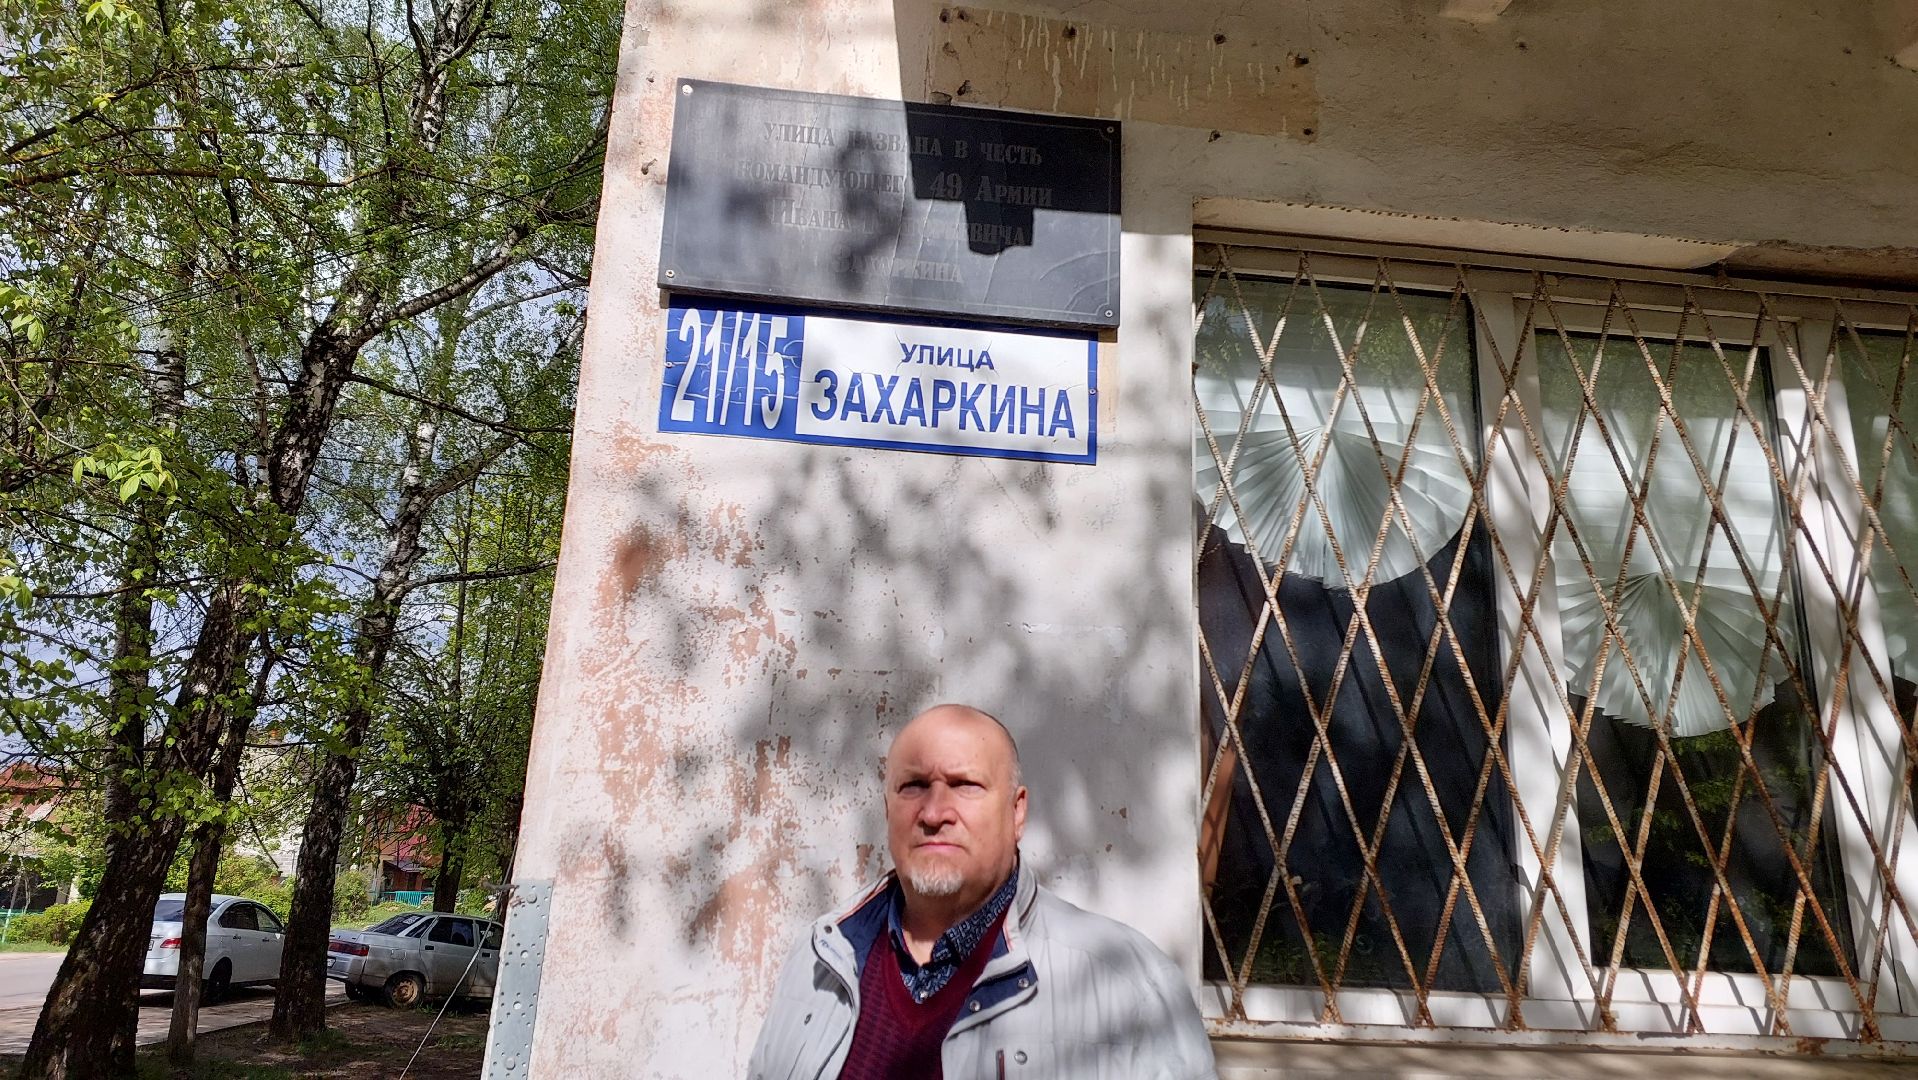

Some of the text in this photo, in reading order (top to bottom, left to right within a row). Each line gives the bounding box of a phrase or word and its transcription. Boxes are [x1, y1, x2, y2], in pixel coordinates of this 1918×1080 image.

[764, 122, 835, 148] УЛИЦА
[954, 140, 968, 159] В
[980, 142, 1042, 166] ЧЕСТЬ
[930, 171, 962, 199] 49
[670, 308, 788, 430] 21/15
[901, 343, 995, 372] УЛИЦА
[811, 369, 1076, 438] ЗАХАРКИНА
